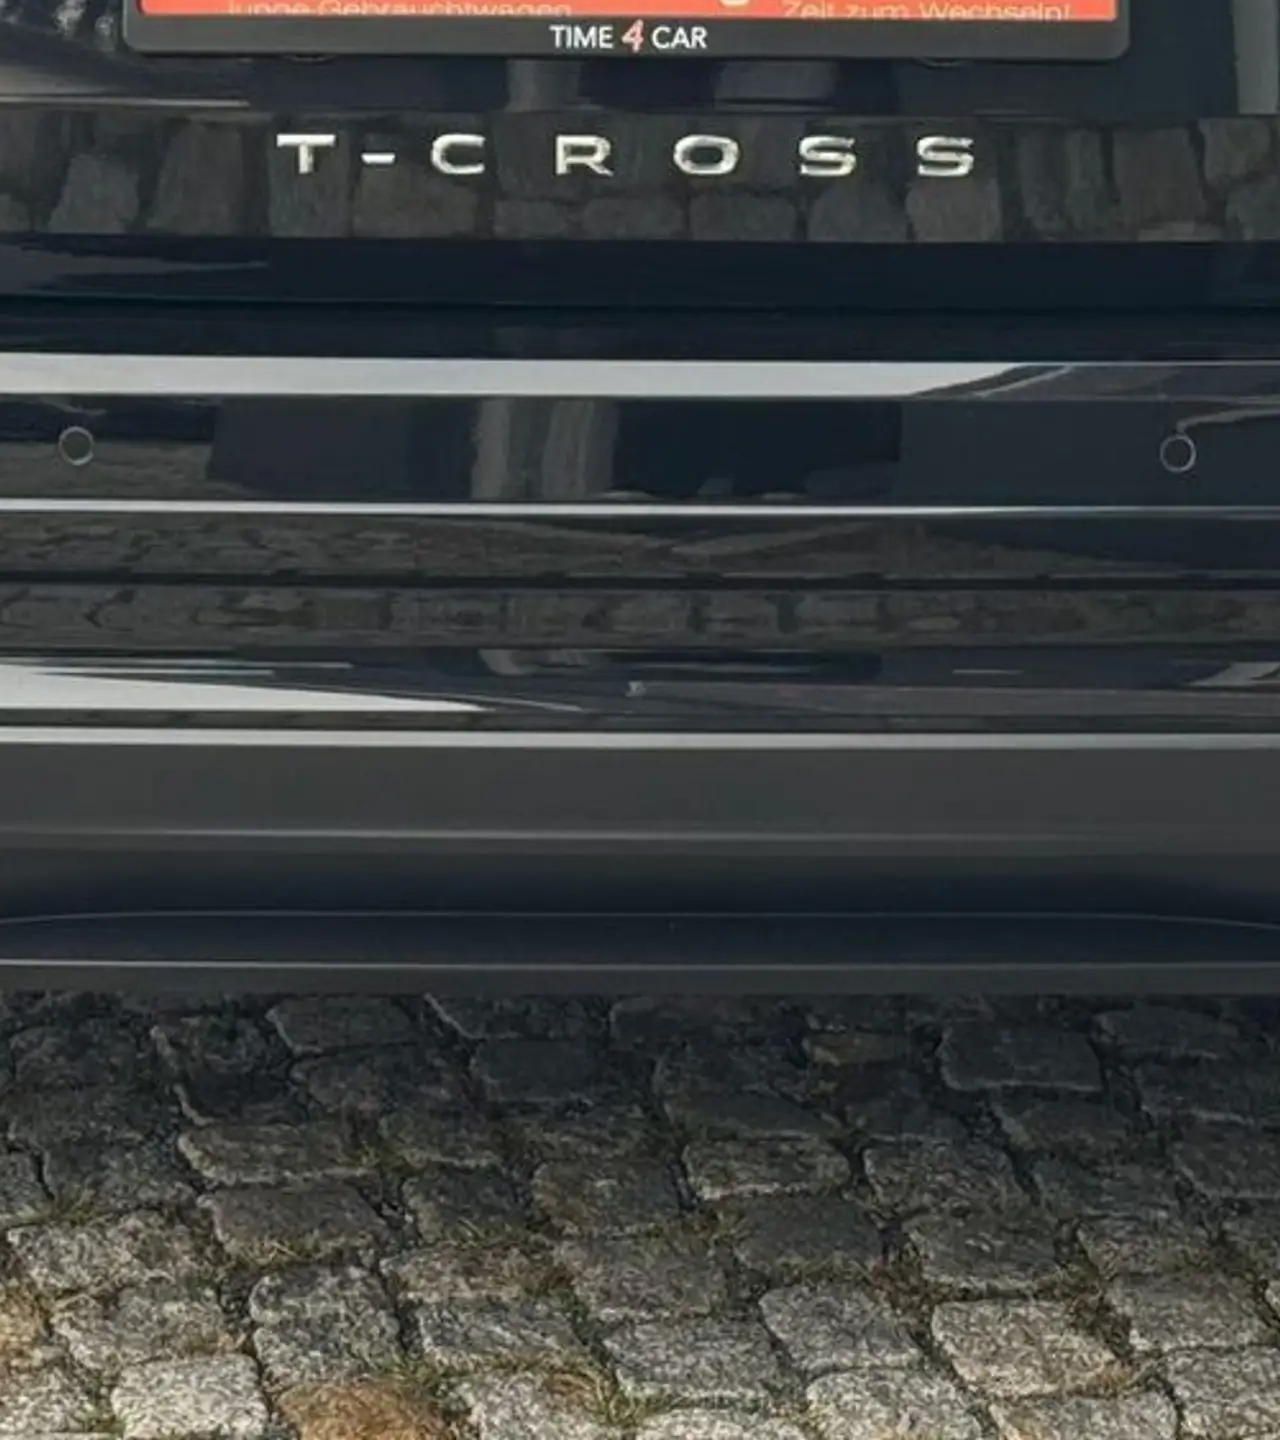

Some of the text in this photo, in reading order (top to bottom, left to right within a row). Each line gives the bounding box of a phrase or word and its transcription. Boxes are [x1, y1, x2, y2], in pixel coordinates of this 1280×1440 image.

[549, 18, 708, 53] TIME 4 CAR
[276, 133, 976, 176] T-CROSS
